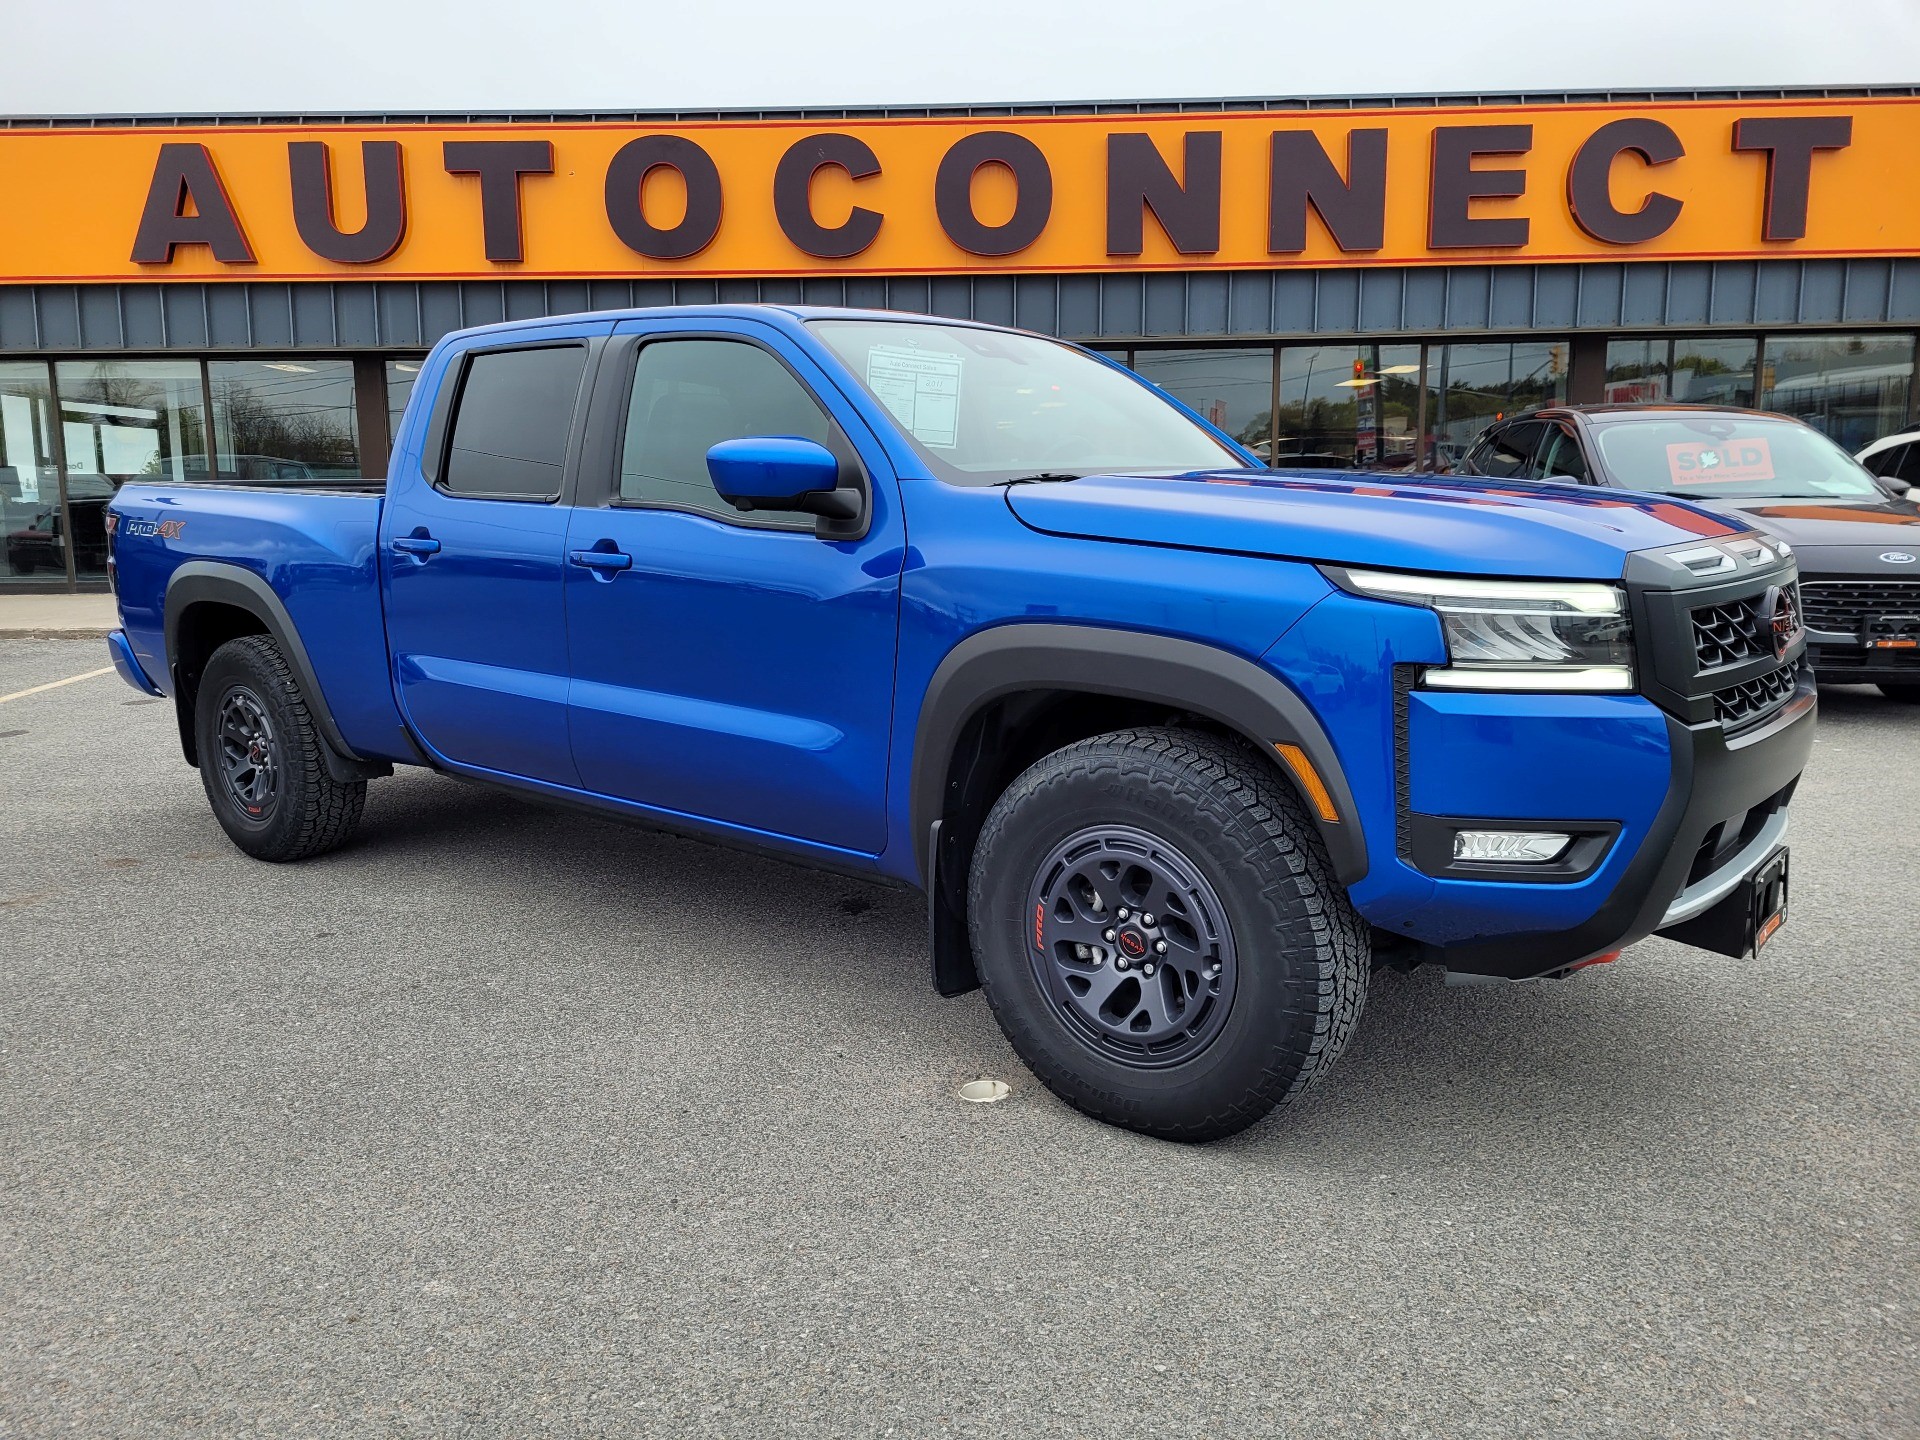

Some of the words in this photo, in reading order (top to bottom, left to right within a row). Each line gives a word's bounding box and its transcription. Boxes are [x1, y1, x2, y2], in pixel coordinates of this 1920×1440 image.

[129, 116, 1853, 264] AUTOCONNECT
[1676, 447, 1763, 471] SOLD
[1036, 904, 1045, 950] PRO
[1121, 933, 1145, 953] NISSAN
